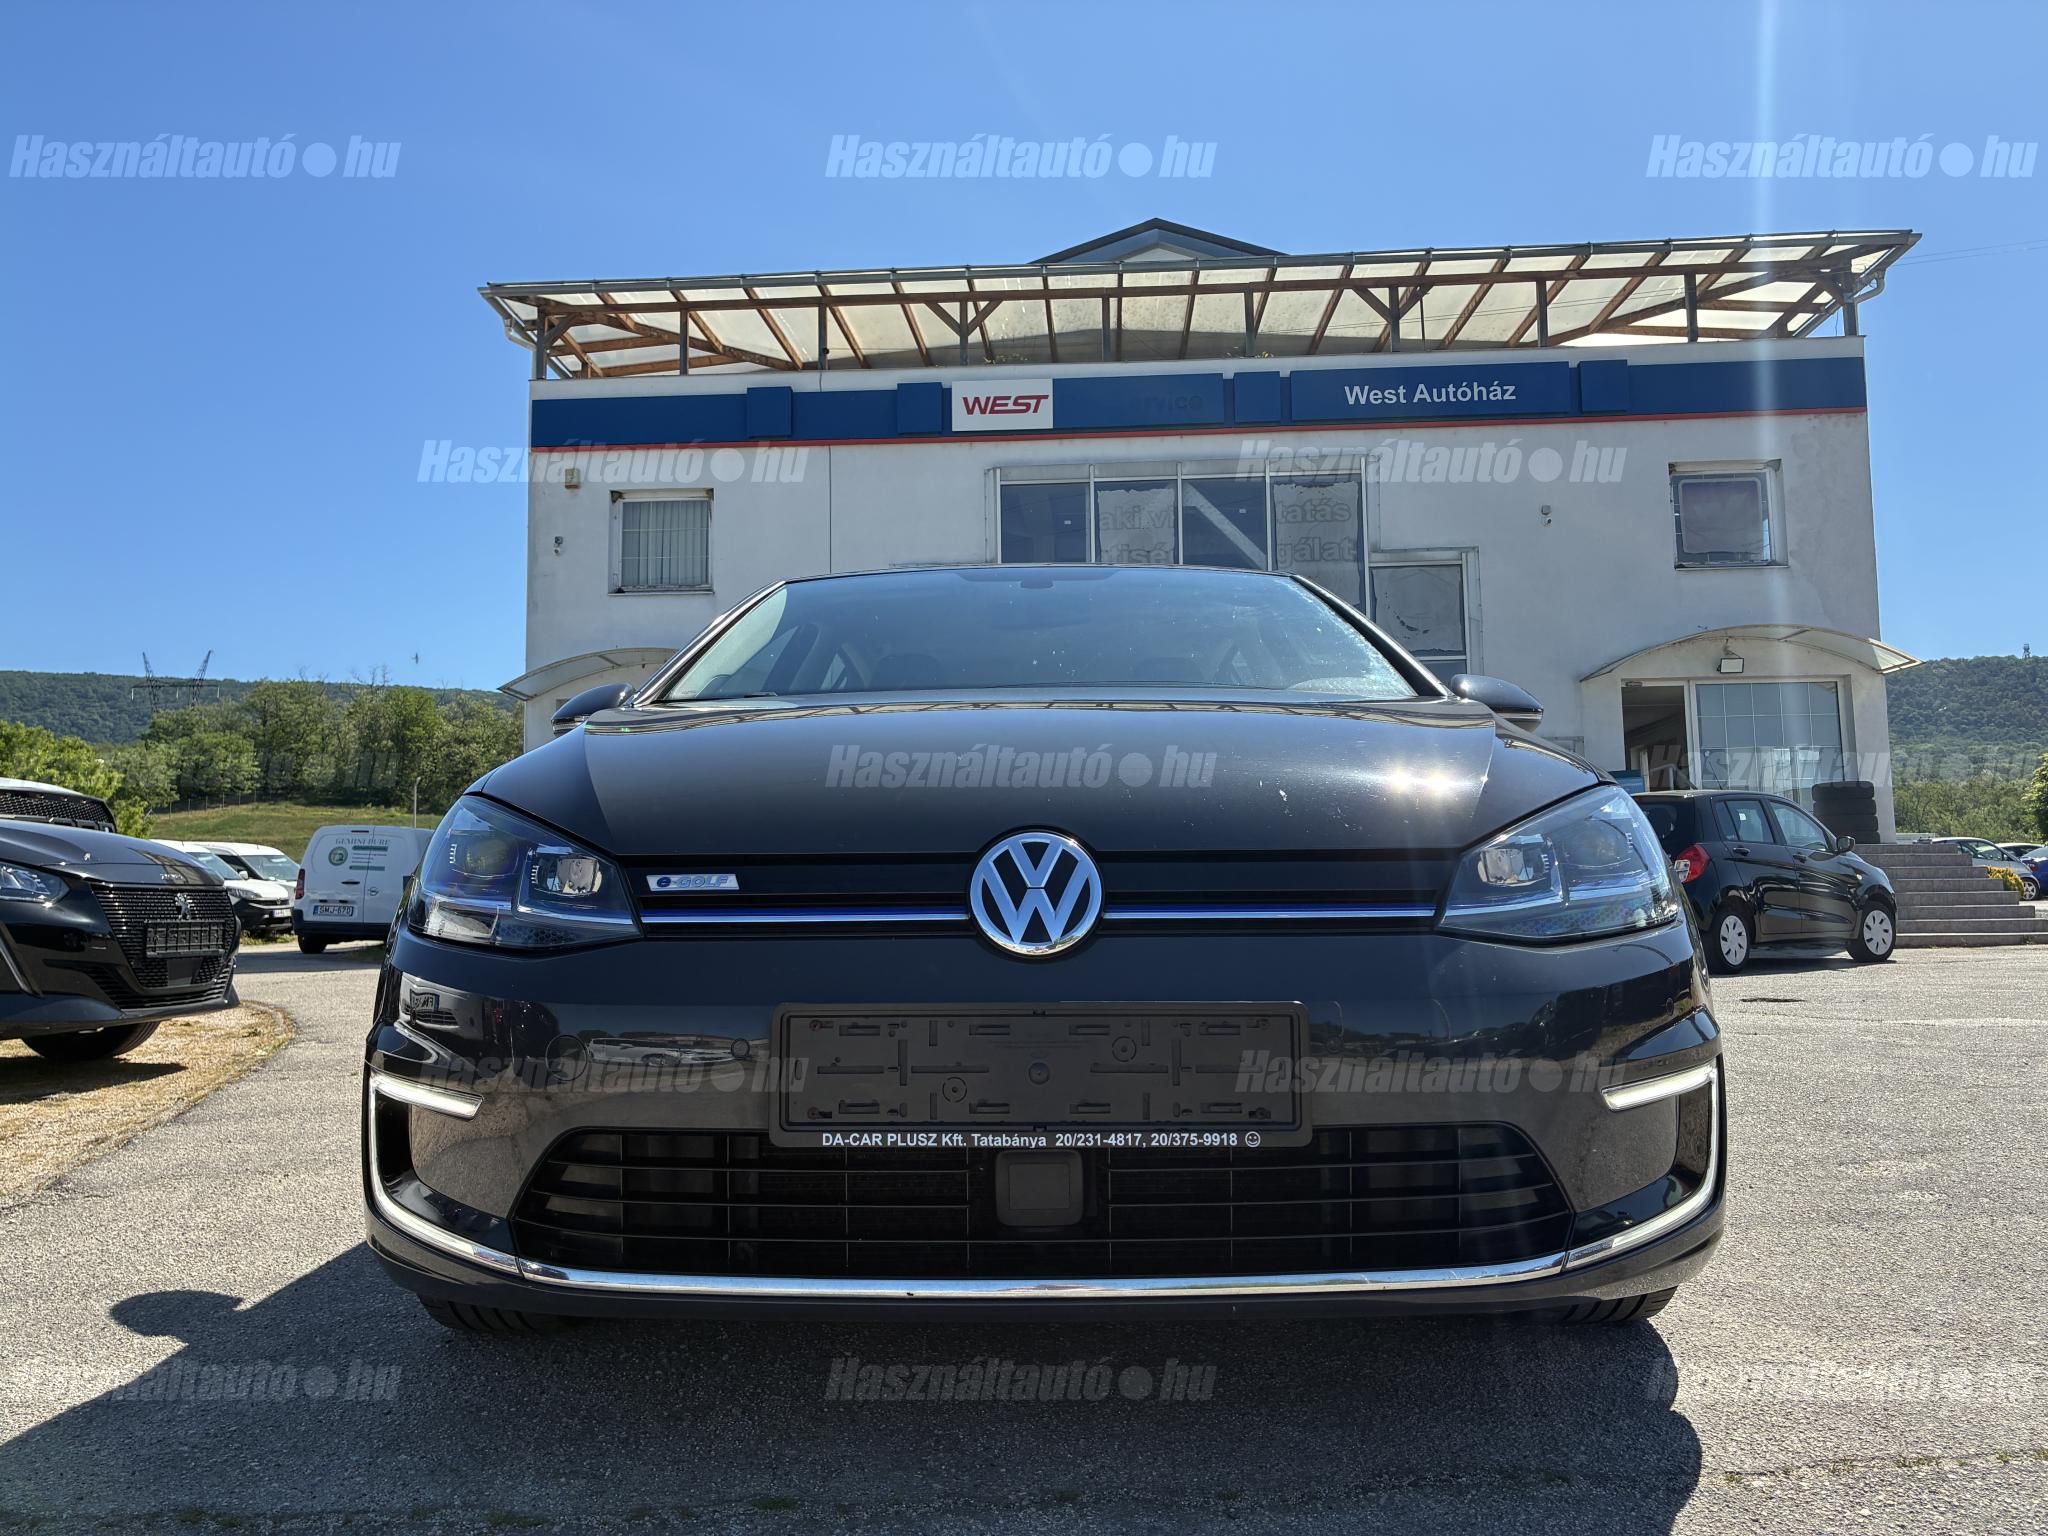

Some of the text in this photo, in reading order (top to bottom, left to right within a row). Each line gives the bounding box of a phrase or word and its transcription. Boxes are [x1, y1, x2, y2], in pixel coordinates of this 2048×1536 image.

[1344, 381, 1516, 405] West Autóház
[962, 394, 1049, 415] WEST
[822, 1133, 1238, 1148] DA-CAR PLUSZ Kft. Tatabánya 20/231-4817, 20/375-9918
